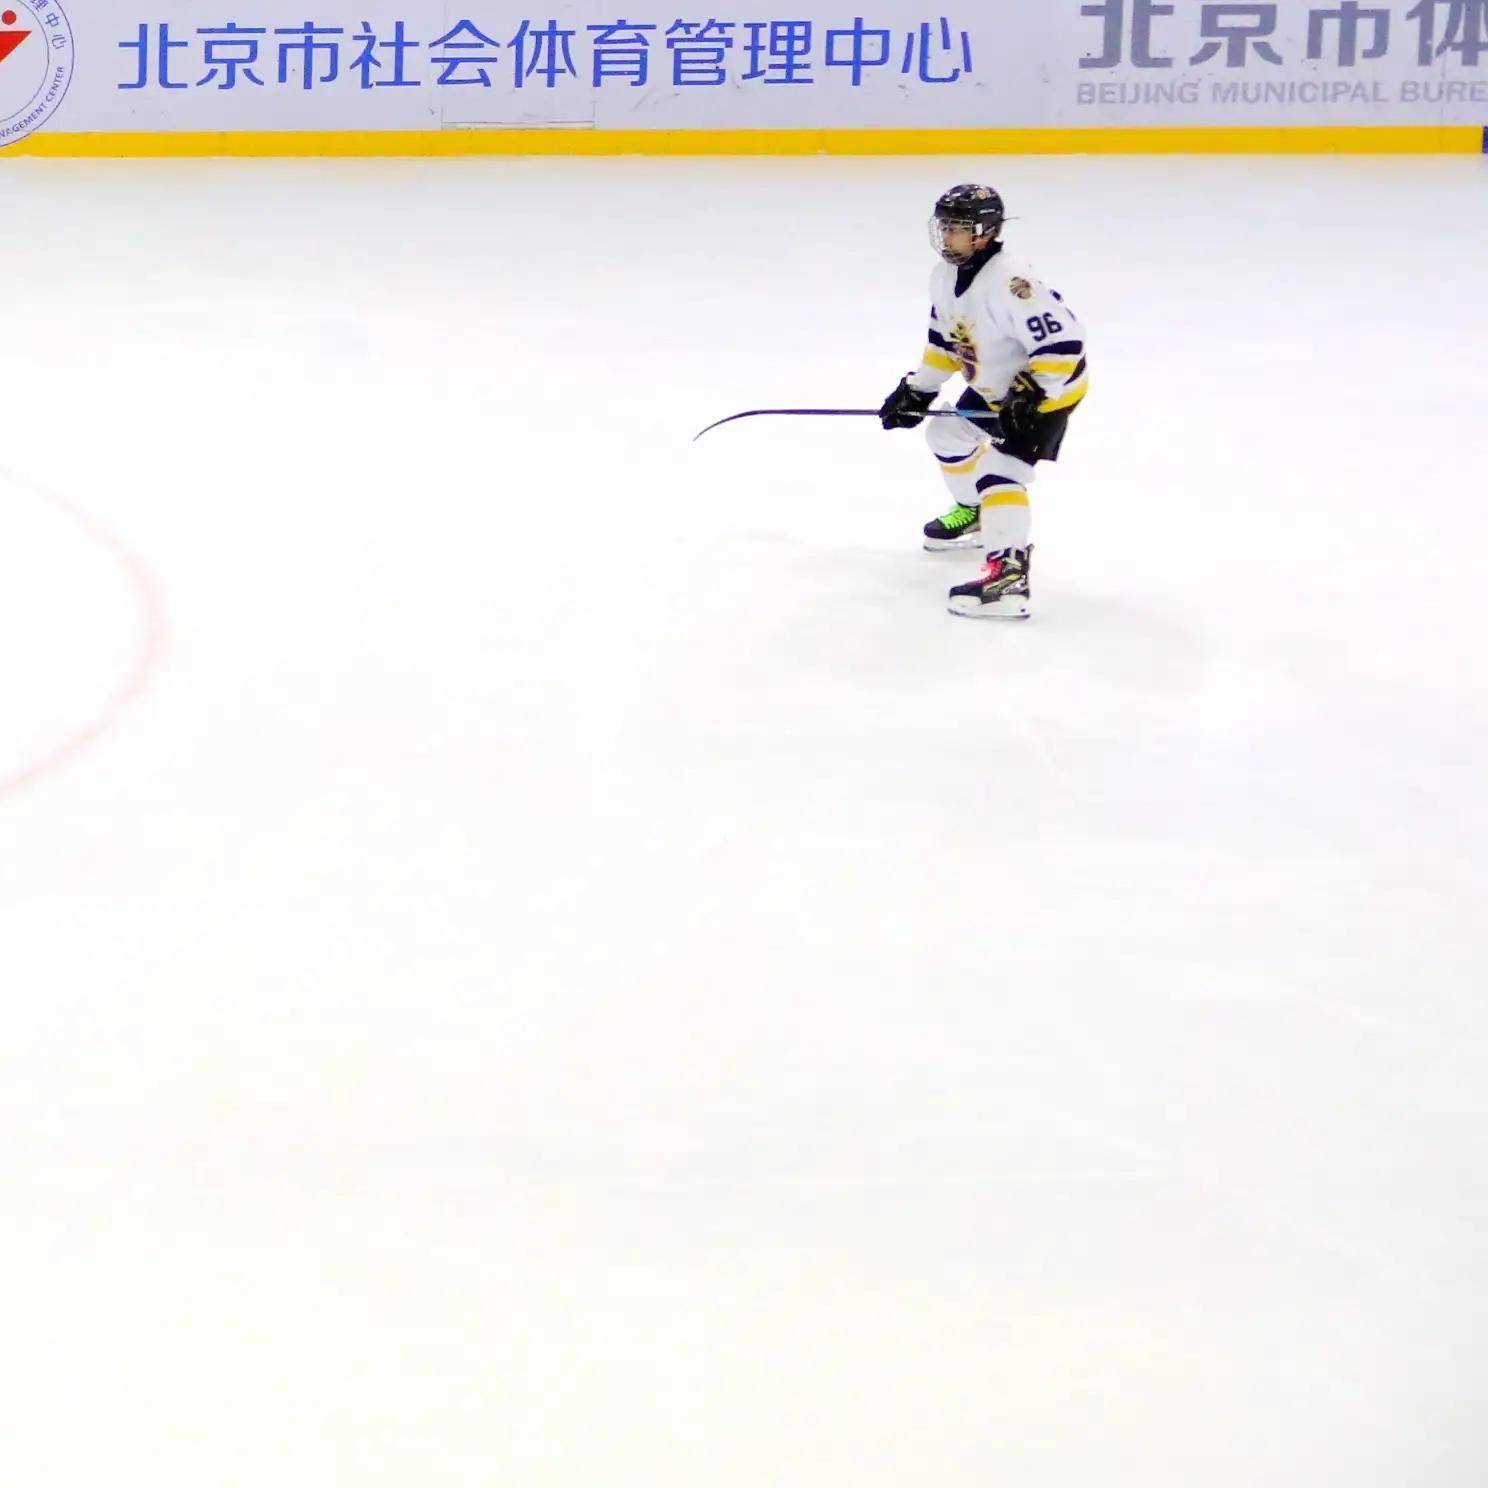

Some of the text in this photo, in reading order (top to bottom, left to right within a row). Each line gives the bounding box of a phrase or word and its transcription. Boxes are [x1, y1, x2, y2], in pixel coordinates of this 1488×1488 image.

[117, 16, 973, 91] 北京市社会体育管理中心
[45, 66, 66, 103] CENTER
[1076, 80, 1200, 106] BEIJING
[1211, 80, 1388, 105] MUNICIPAL
[1026, 311, 1064, 342] 96
